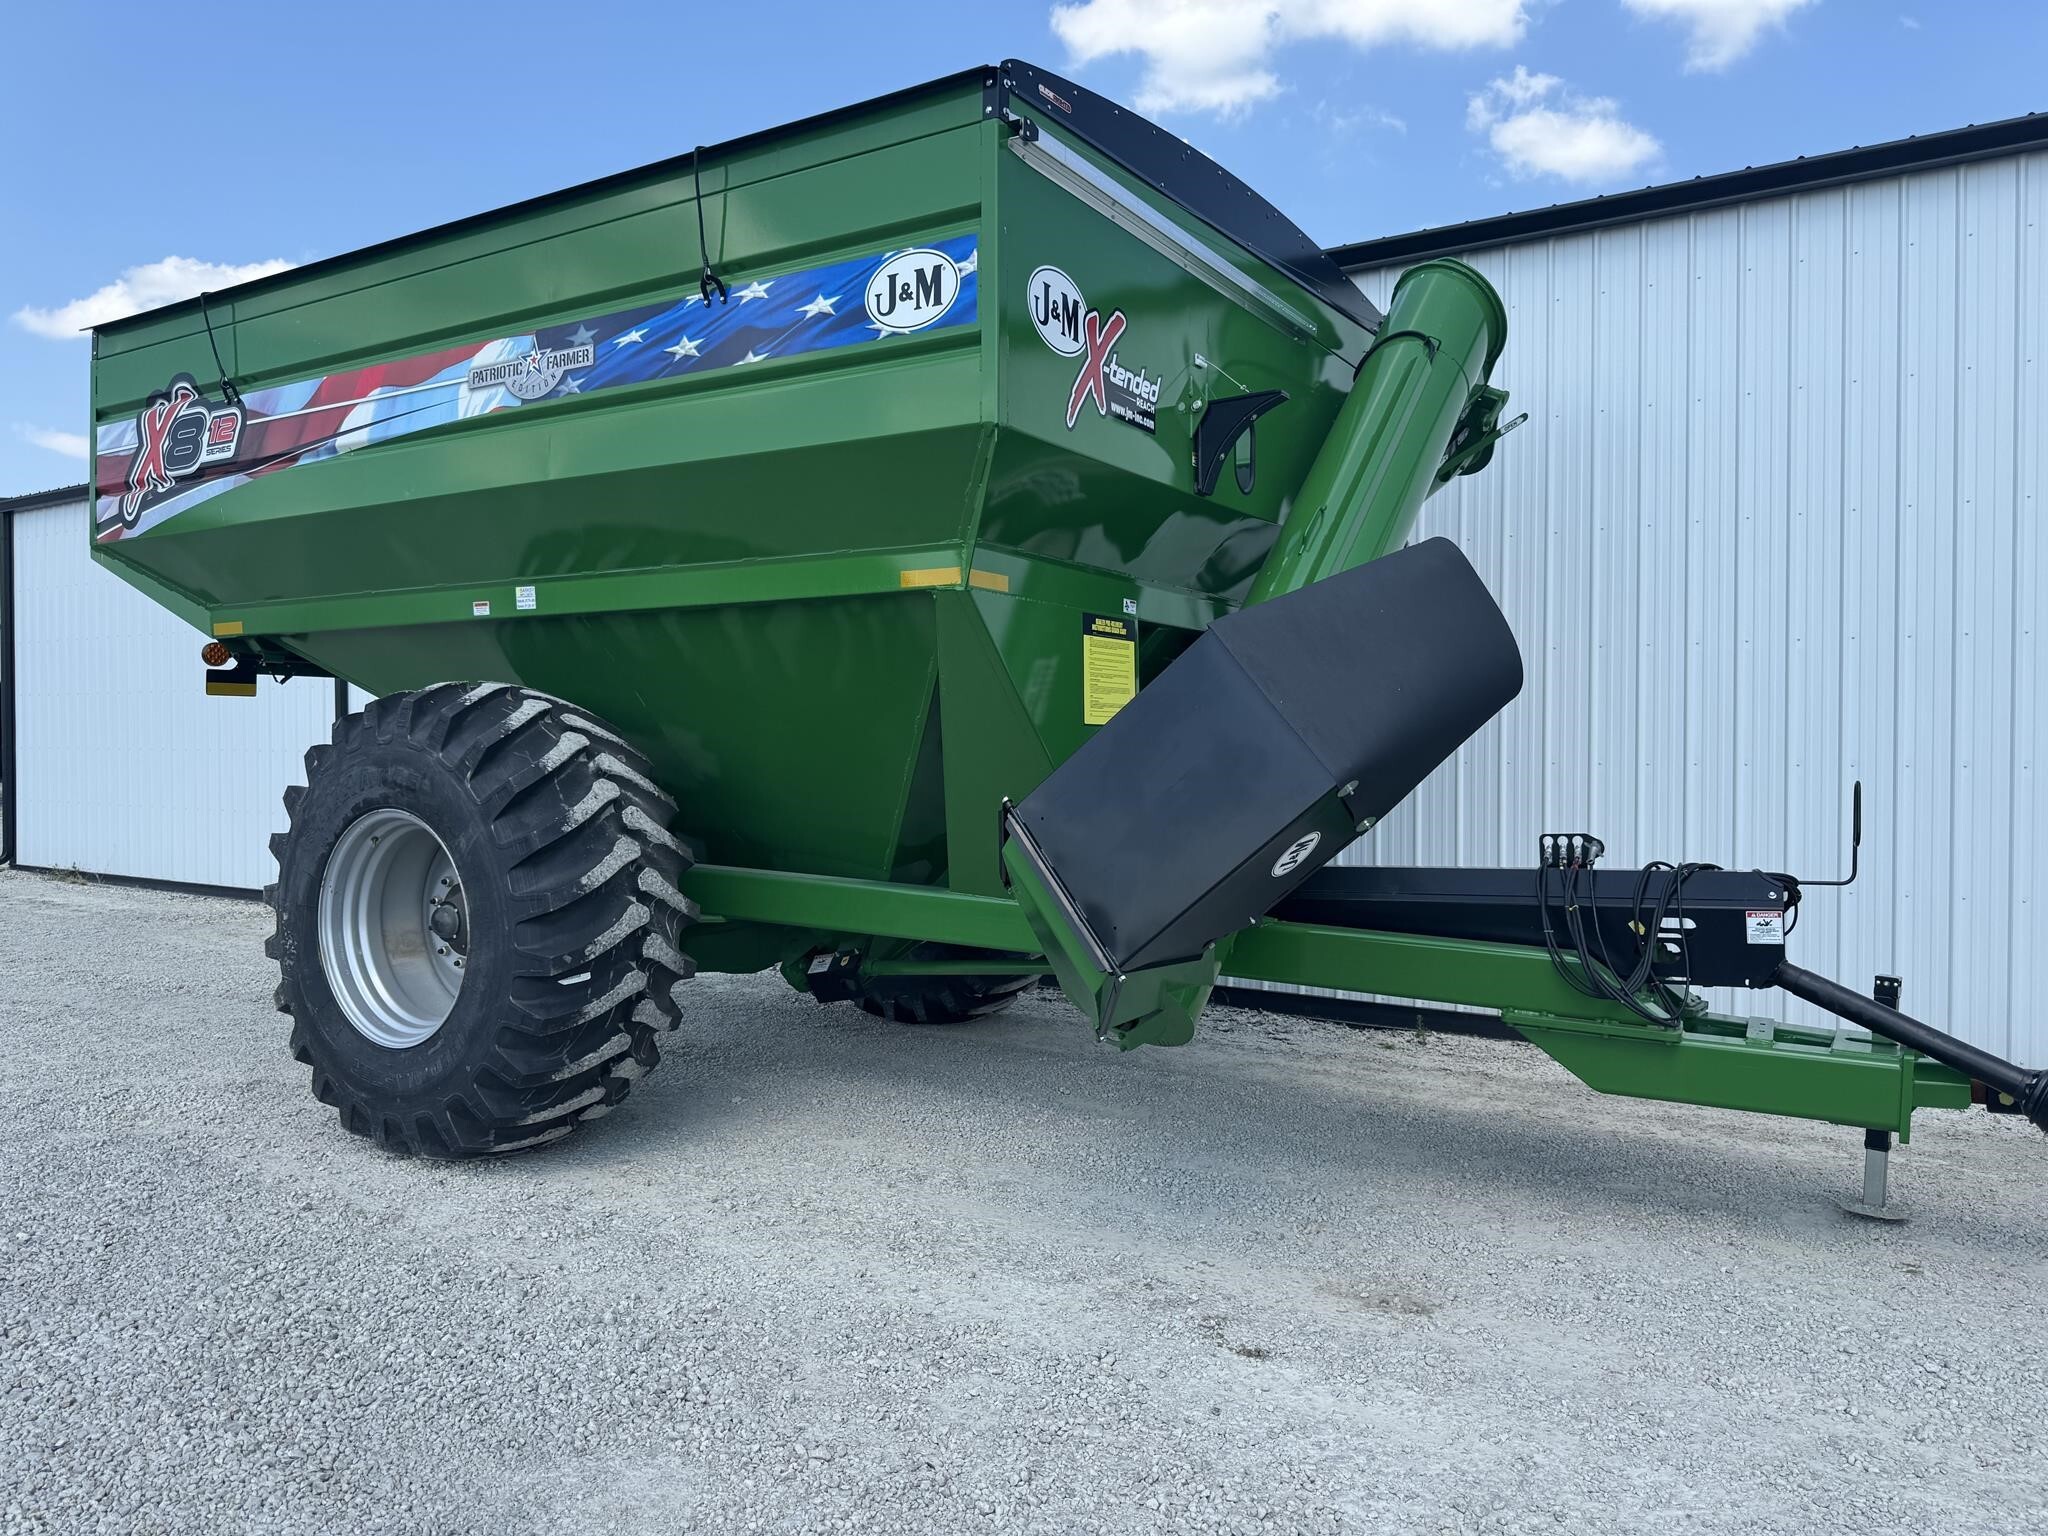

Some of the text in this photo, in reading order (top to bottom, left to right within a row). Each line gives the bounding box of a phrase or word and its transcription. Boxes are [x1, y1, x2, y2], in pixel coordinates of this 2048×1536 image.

[874, 264, 943, 317] J&M
[1034, 281, 1080, 344] J&M
[472, 348, 590, 384] PATRIOTIC FARMER
[511, 372, 557, 393] EDITION
[1136, 397, 1155, 414] REACH
[206, 445, 232, 456] SERIES
